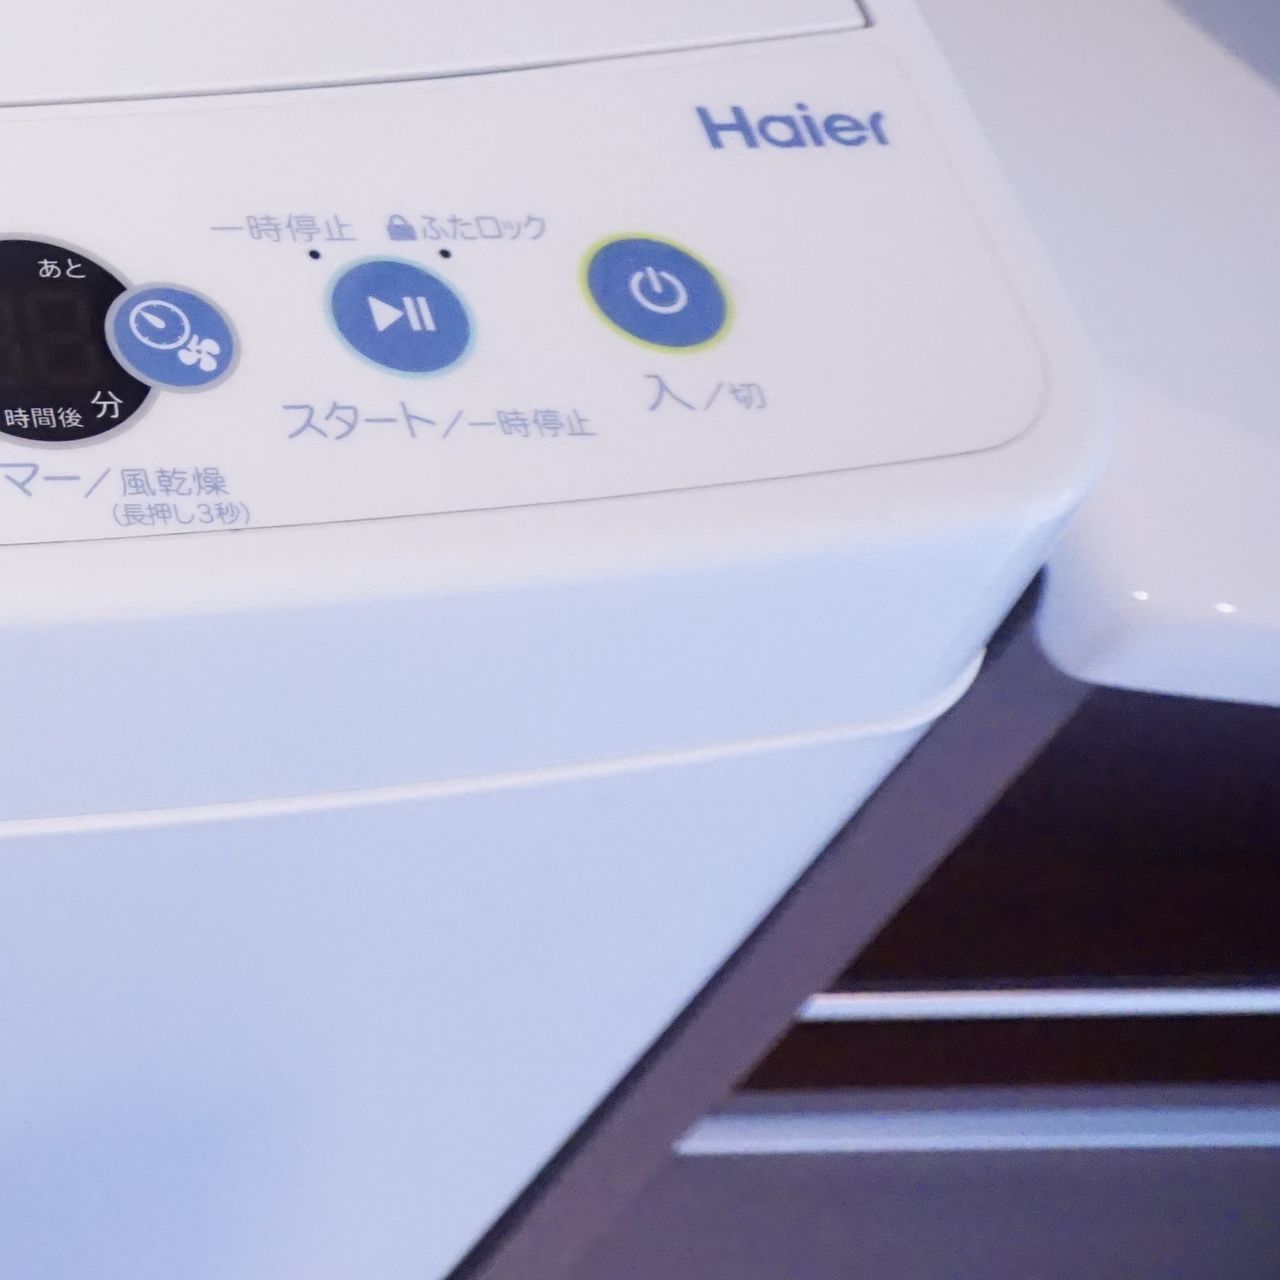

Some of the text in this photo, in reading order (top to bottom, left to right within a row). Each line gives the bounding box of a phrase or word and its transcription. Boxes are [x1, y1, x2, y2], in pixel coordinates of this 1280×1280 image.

[696, 103, 889, 149] Haier
[210, 214, 357, 242] 一時停止
[421, 214, 546, 240] ふたロック
[38, 259, 86, 279] あと
[3, 406, 83, 430] 時間後
[91, 391, 124, 419] 分
